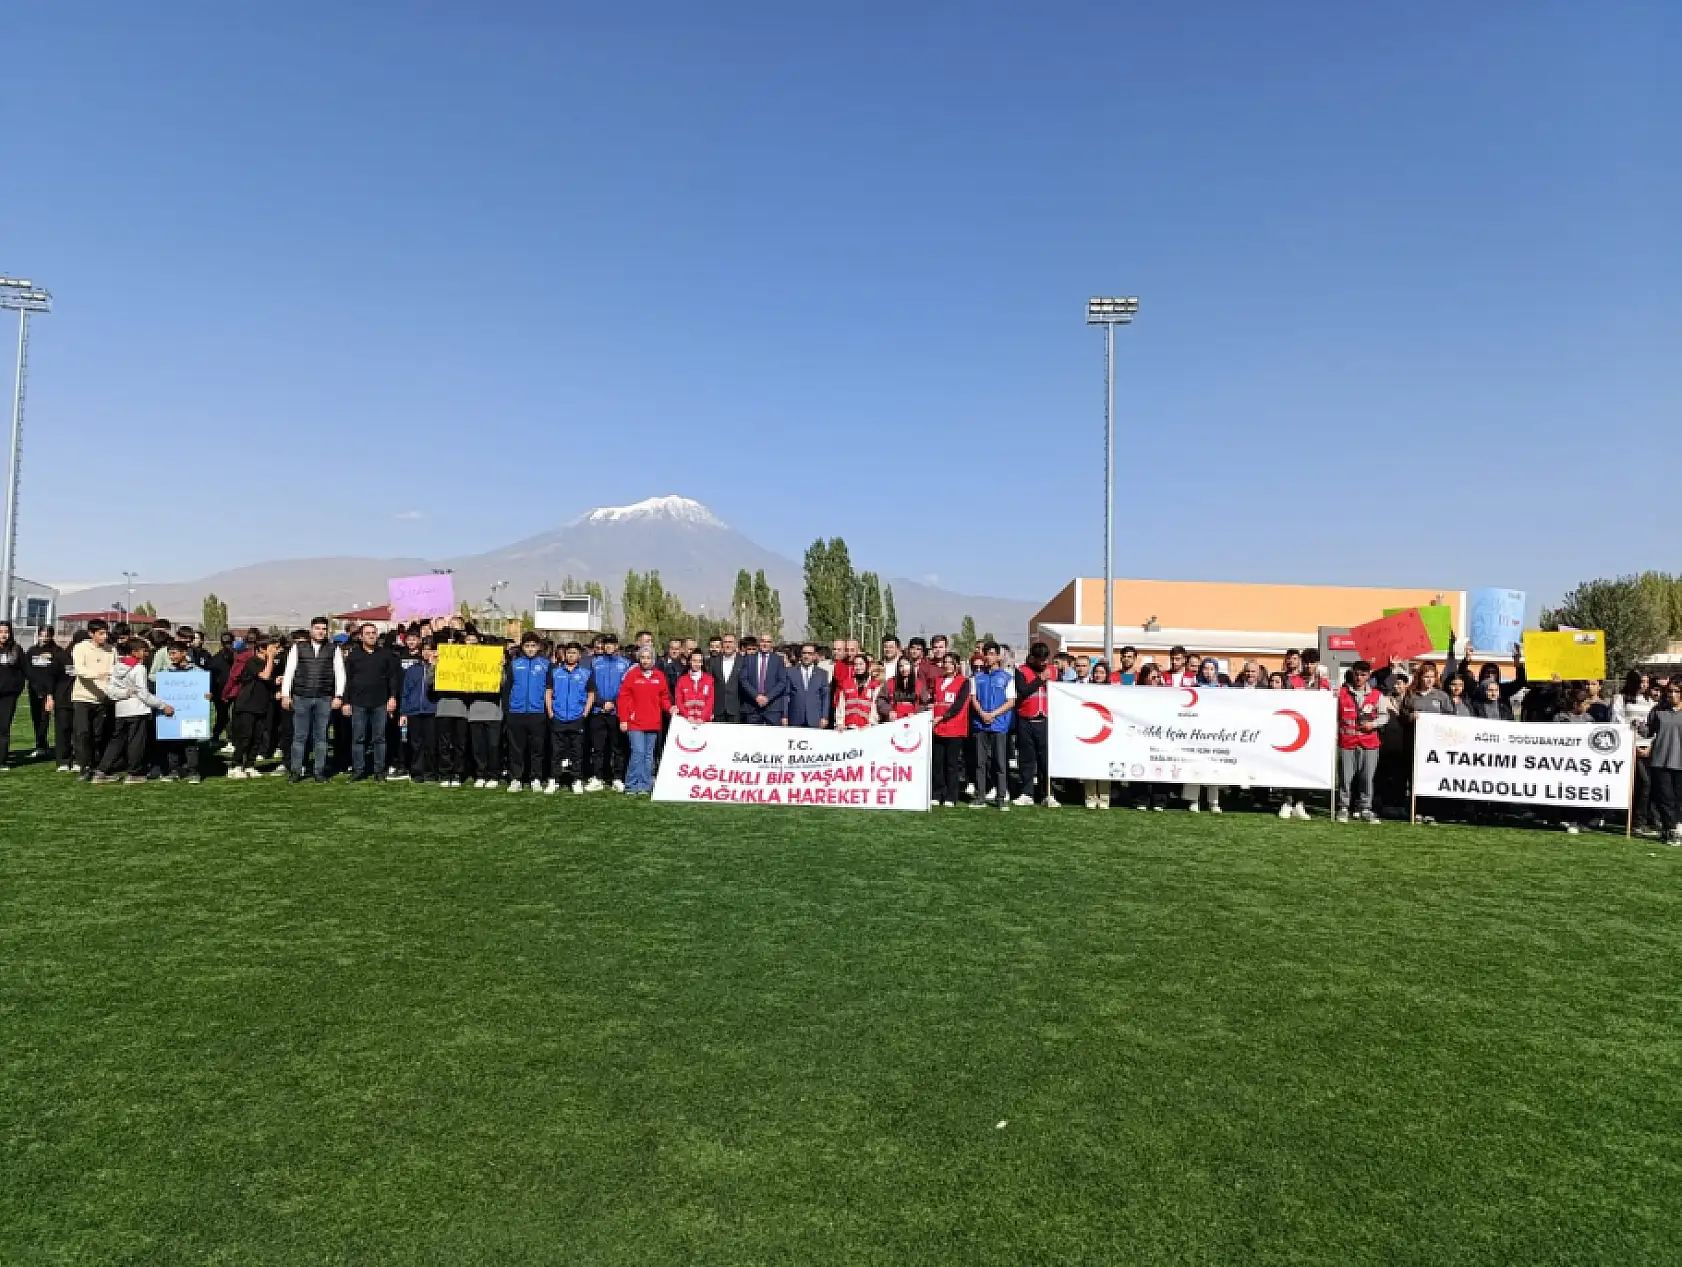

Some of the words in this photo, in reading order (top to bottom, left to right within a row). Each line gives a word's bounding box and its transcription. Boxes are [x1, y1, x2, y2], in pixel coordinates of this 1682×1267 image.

[787, 739, 813, 750] T.C.
[1474, 732, 1500, 744] AĞRI
[1508, 734, 1583, 747] DOĞUBAYAZIT
[732, 751, 785, 764] SAĞLIK
[787, 749, 864, 764] BAKANLIĞI
[1426, 750, 1440, 764] A
[1446, 751, 1517, 769] TAKIMI
[1524, 755, 1592, 776] SAVAŞ
[1598, 760, 1624, 774] AY
[677, 764, 761, 785] SAĞLIKLI
[765, 765, 795, 785] BİR
[802, 765, 864, 787] YAŞAM
[870, 761, 913, 786] İÇİN
[689, 784, 781, 804] SAĞLIKLA
[788, 787, 871, 804] HAREKET
[876, 785, 897, 805] ET
[1438, 777, 1538, 797] ANADOLU
[1544, 781, 1611, 802] LİSESİ
